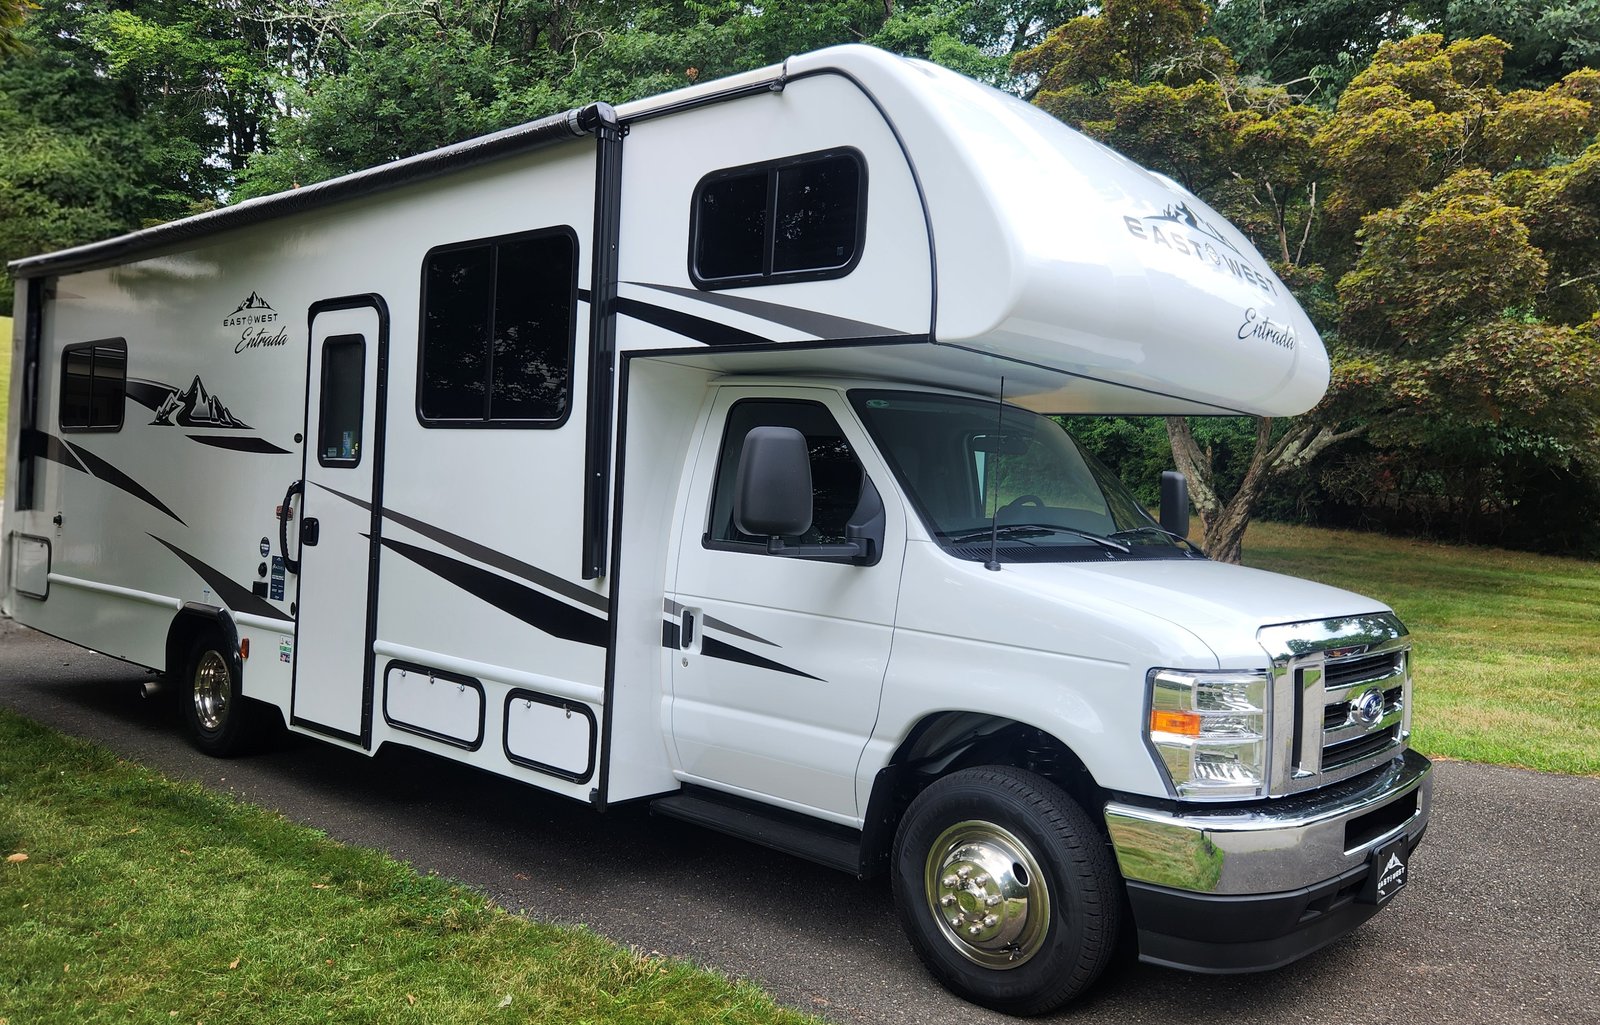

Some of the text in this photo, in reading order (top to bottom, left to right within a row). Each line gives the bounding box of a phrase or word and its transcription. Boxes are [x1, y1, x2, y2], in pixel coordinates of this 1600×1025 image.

[1123, 215, 1278, 296] EAST WEST
[223, 313, 278, 327] EAST WEST
[1238, 307, 1295, 350] Entrada
[235, 326, 287, 354] Entrada
